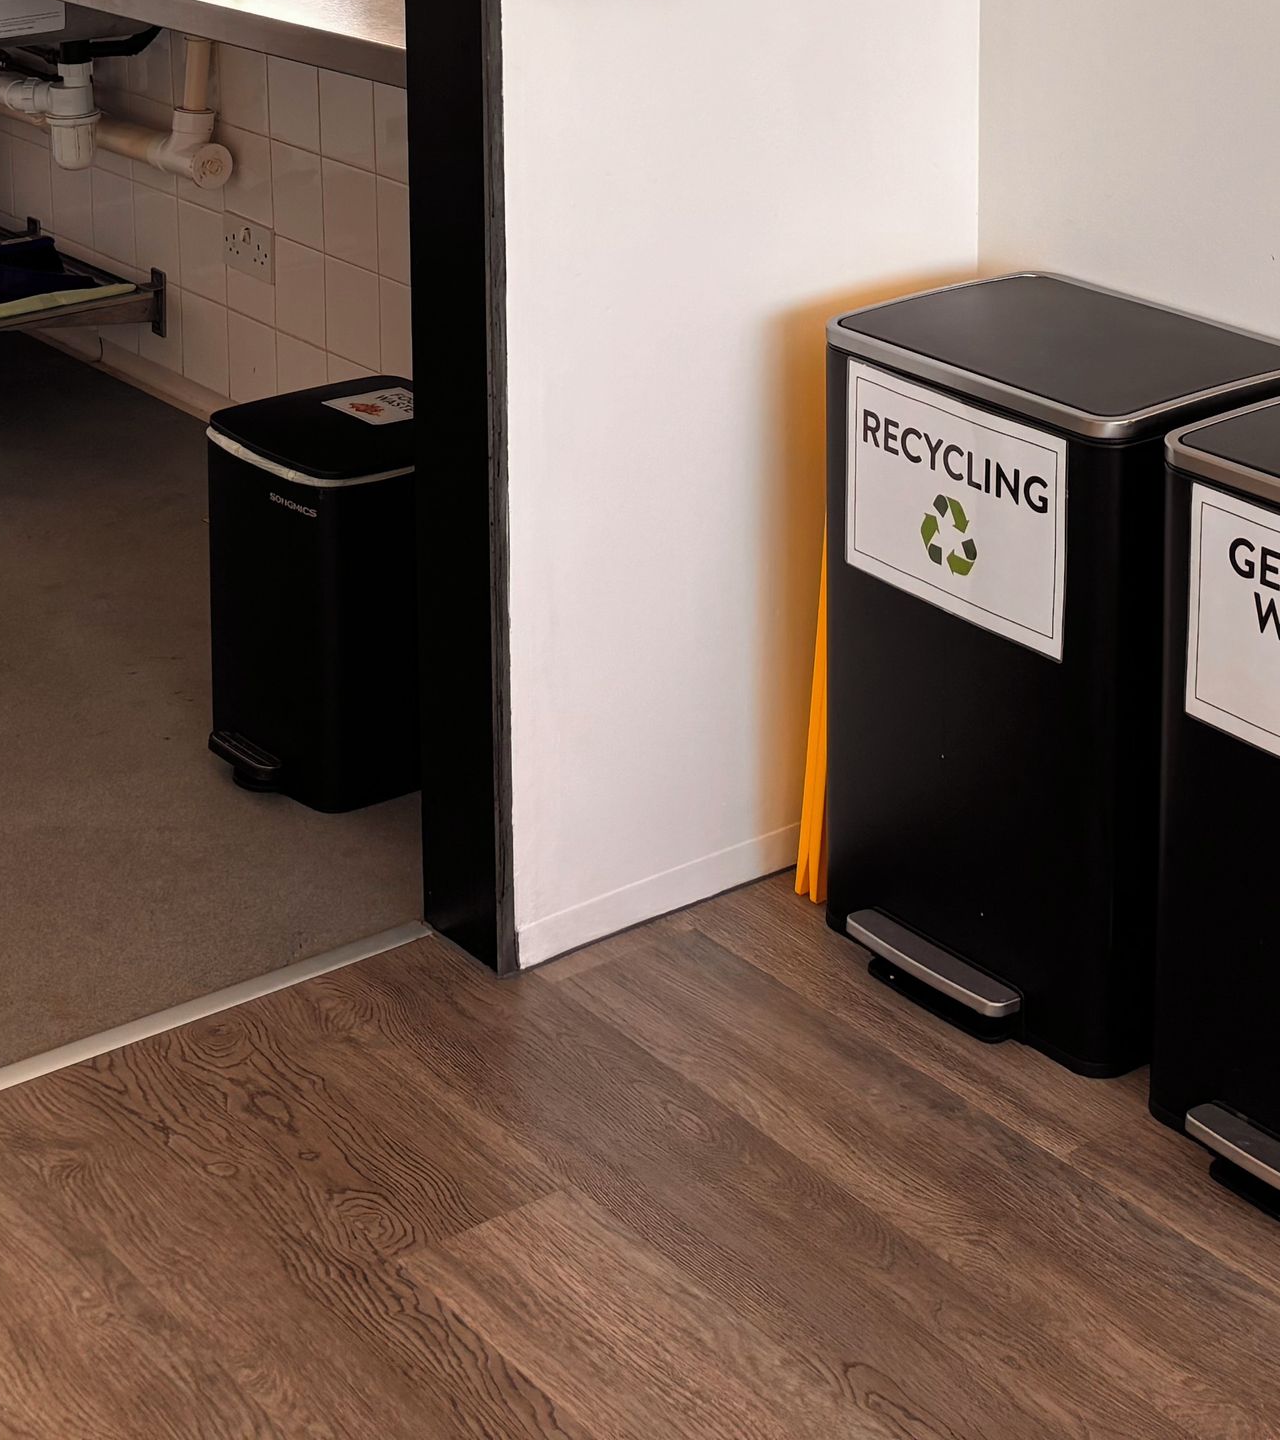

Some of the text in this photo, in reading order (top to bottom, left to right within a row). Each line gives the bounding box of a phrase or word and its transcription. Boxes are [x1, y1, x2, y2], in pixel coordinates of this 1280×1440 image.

[376, 395, 412, 413] WASTE
[862, 408, 1049, 514] RECYCLING
[269, 491, 318, 518] SONGMICS
